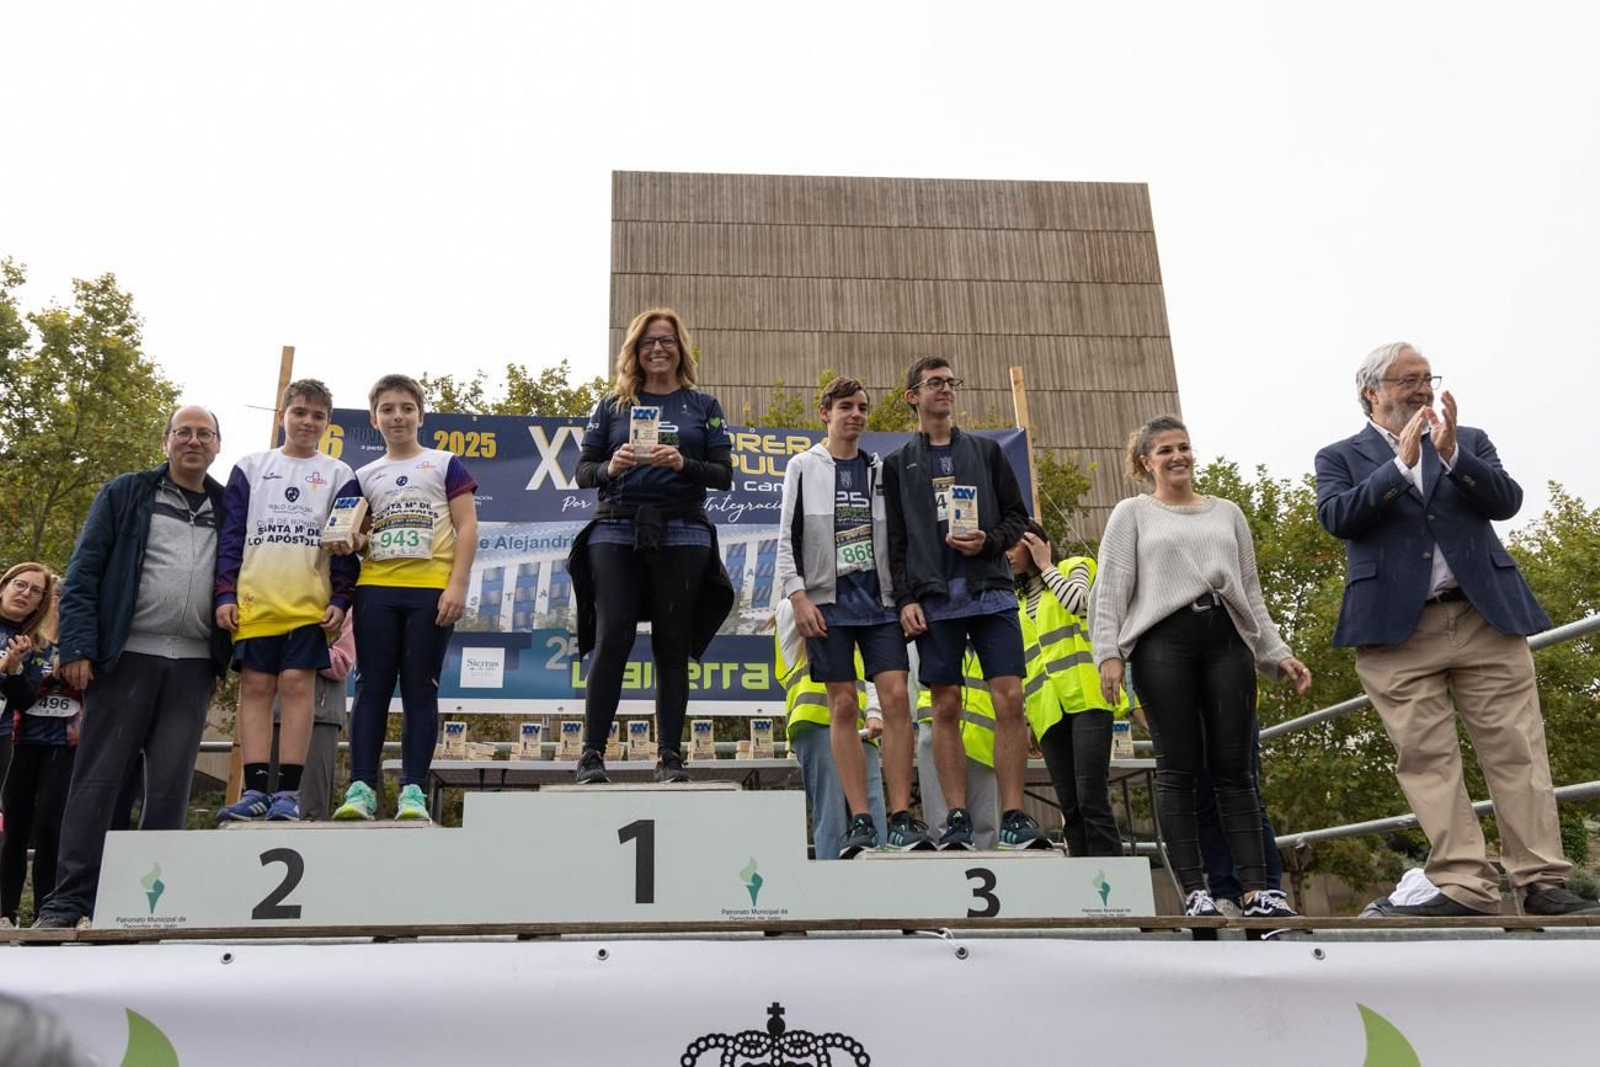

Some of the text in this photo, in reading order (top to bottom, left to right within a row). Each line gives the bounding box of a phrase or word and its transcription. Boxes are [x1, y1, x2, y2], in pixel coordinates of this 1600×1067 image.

[434, 430, 497, 458] 2025
[562, 495, 592, 512] Por
[836, 490, 870, 508] 25
[380, 530, 419, 548] 943
[39, 697, 70, 710] 496
[617, 819, 655, 904] 1
[251, 848, 304, 920] 2
[965, 867, 1000, 918] 3
